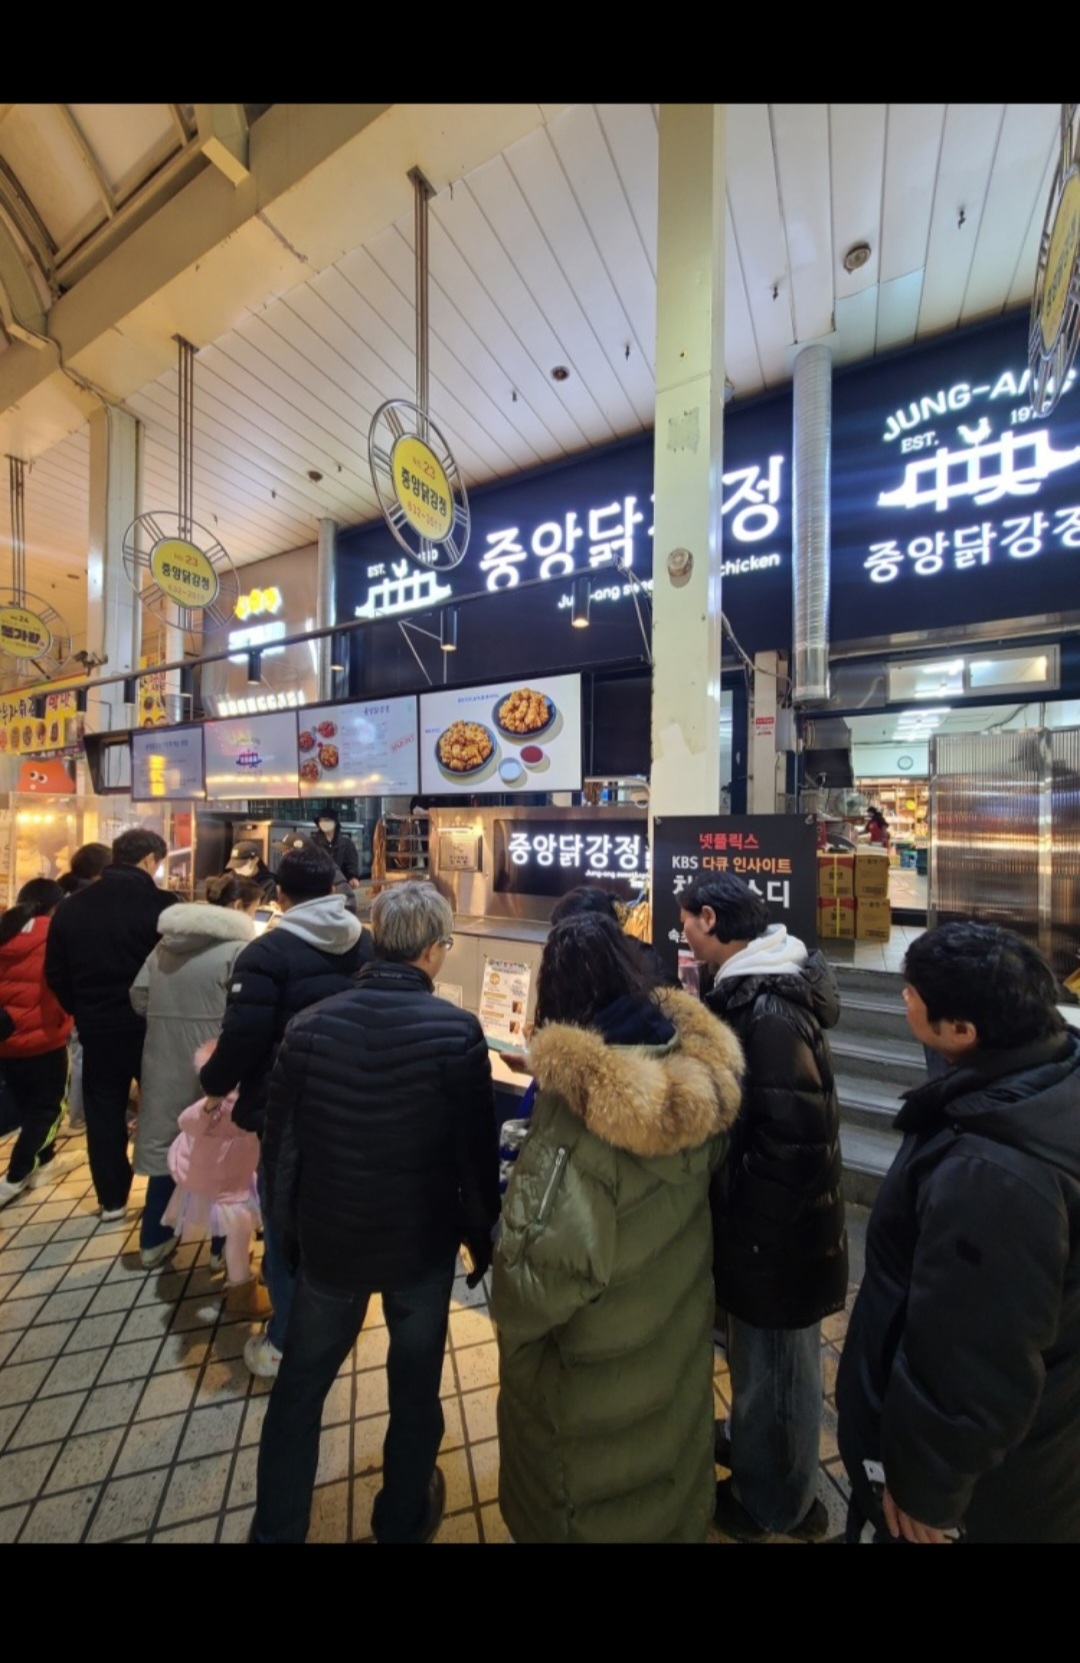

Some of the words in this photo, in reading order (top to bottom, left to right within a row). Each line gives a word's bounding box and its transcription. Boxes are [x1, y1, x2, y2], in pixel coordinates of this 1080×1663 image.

[901, 431, 939, 454] EST.
[401, 465, 447, 517] 중앙닭강정
[480, 455, 784, 592] 중앙닭정
[161, 562, 210, 591] 중앙닭강정
[557, 583, 621, 609] Ju-ang
[508, 832, 641, 870] 중앙닭강정
[699, 833, 759, 850] 넷플릭스
[672, 856, 698, 869] KBS
[702, 857, 728, 871] 다큐
[733, 857, 792, 873] 인사이트
